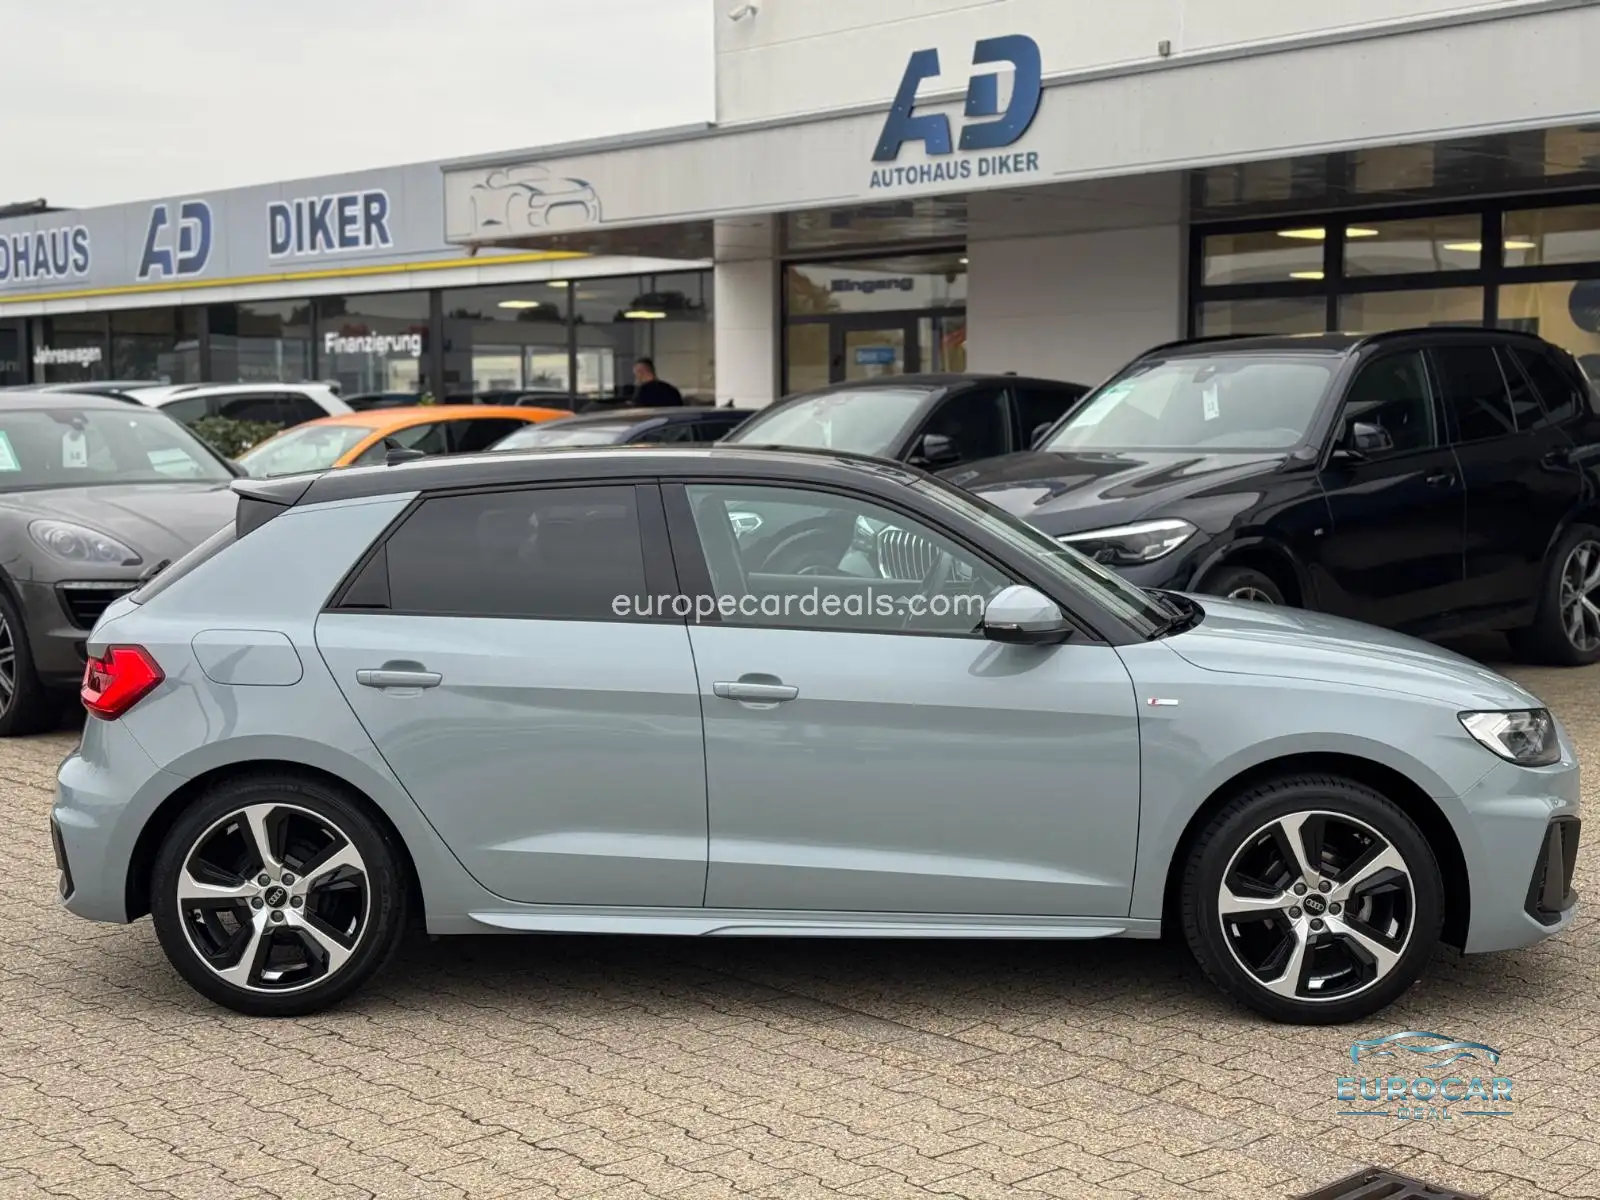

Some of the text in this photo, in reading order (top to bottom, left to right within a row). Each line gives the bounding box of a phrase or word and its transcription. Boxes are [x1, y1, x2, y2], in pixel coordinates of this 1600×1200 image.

[869, 151, 1040, 189] AUTOHAUS DIKER
[267, 188, 393, 259] DIKER
[830, 277, 914, 294] Eingang
[324, 331, 422, 357] Finanzierung
